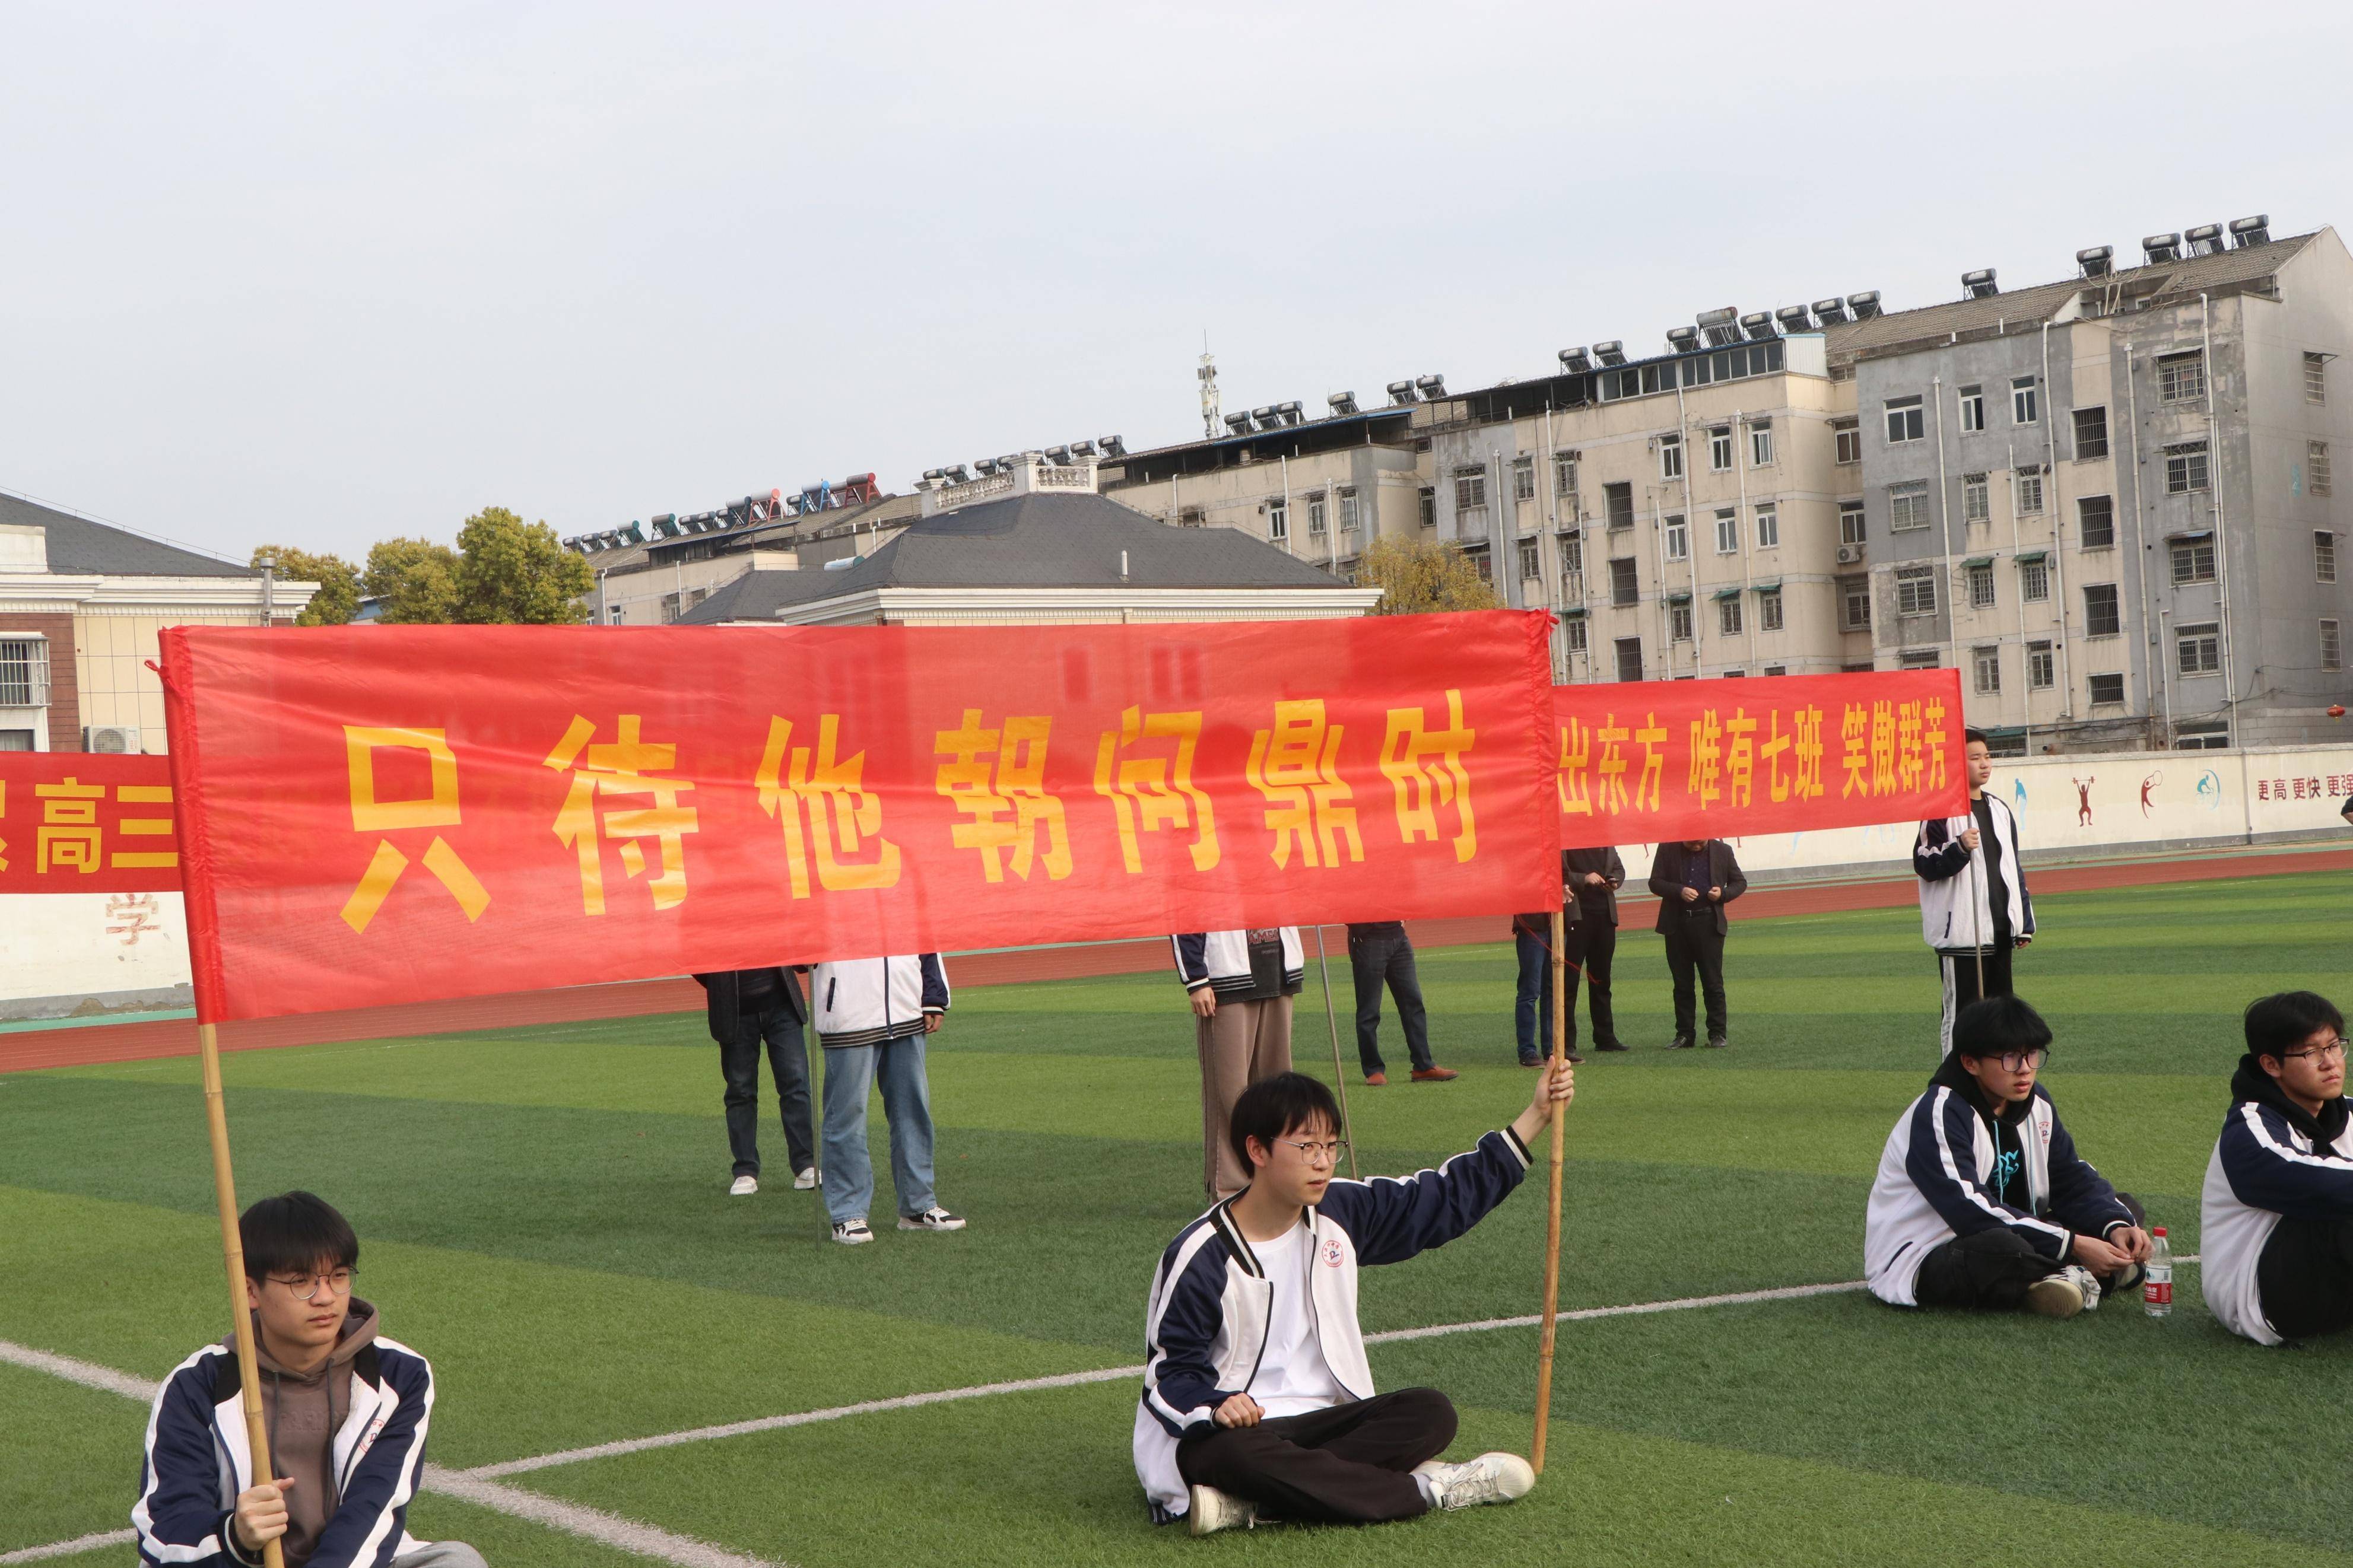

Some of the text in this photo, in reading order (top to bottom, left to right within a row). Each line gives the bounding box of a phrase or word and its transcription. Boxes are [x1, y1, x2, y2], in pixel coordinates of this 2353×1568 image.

[1557, 697, 1946, 816] 出东方 唯有七班 笑傲群芳
[2258, 778, 2287, 801] 更高
[2292, 776, 2321, 800] 更快
[339, 689, 1477, 934] 只待他朝问鼎时
[106, 892, 161, 945] 学
